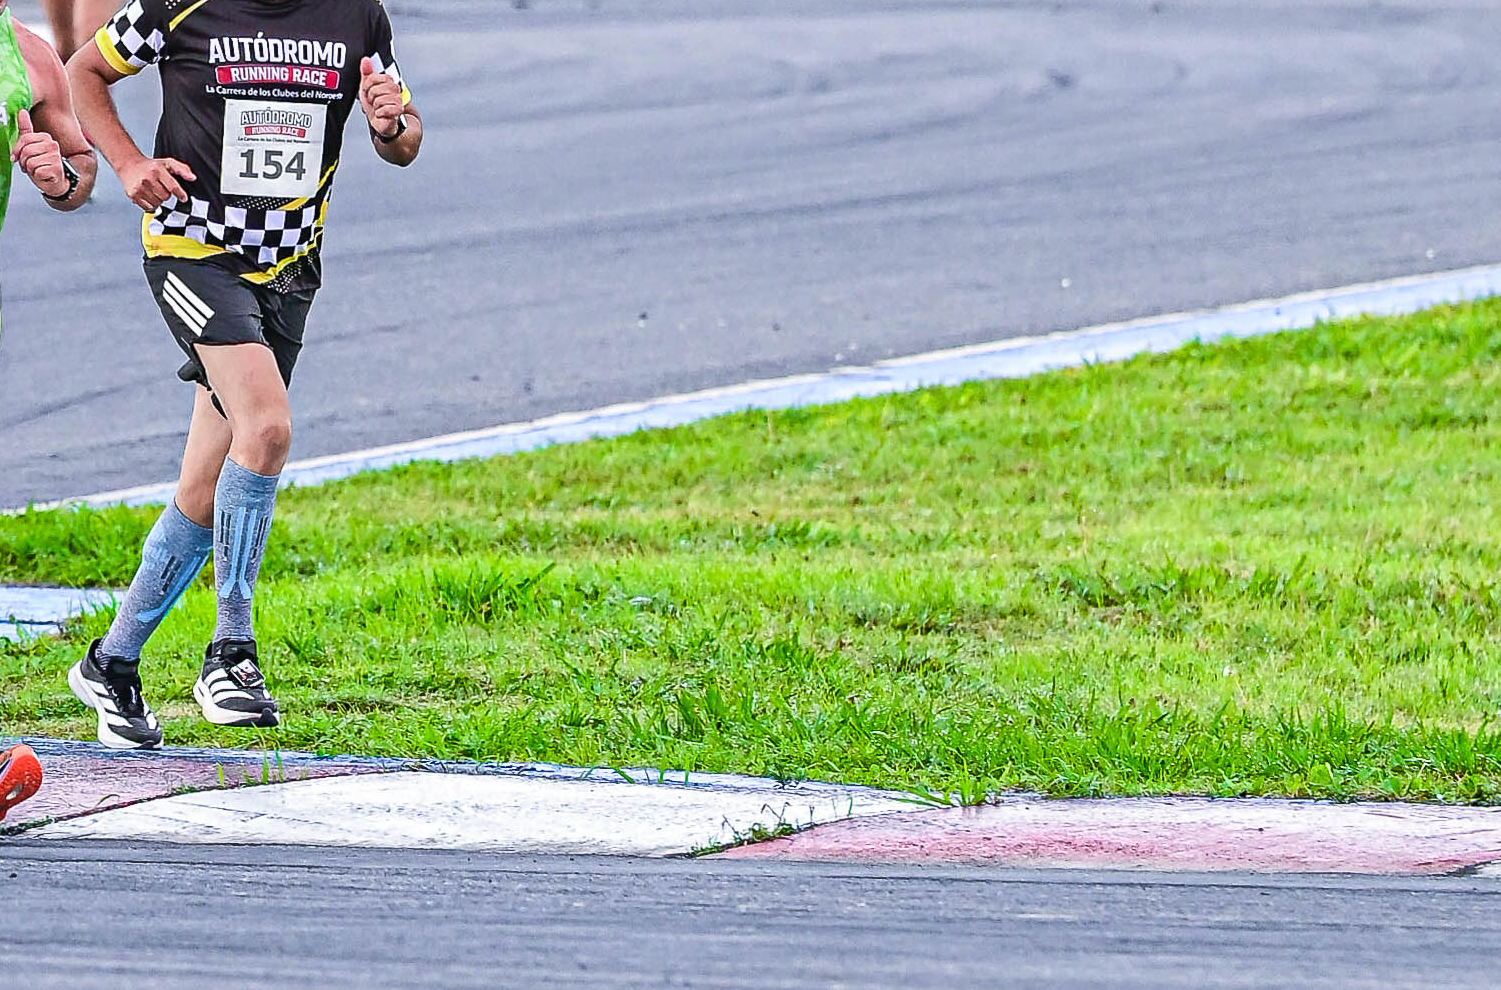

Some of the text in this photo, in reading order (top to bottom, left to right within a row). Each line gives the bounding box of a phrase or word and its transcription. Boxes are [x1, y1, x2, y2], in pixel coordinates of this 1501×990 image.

[209, 31, 346, 68] AUTÓDROMO
[230, 66, 327, 86] RUNNING RACE
[205, 84, 215, 93] La
[216, 85, 246, 96] Carrera
[248, 86, 258, 96] de
[260, 87, 271, 97] los
[272, 88, 299, 98] Clubes
[301, 89, 314, 99] del
[240, 106, 312, 128] AUTÓDROMO
[239, 149, 306, 180] 154
